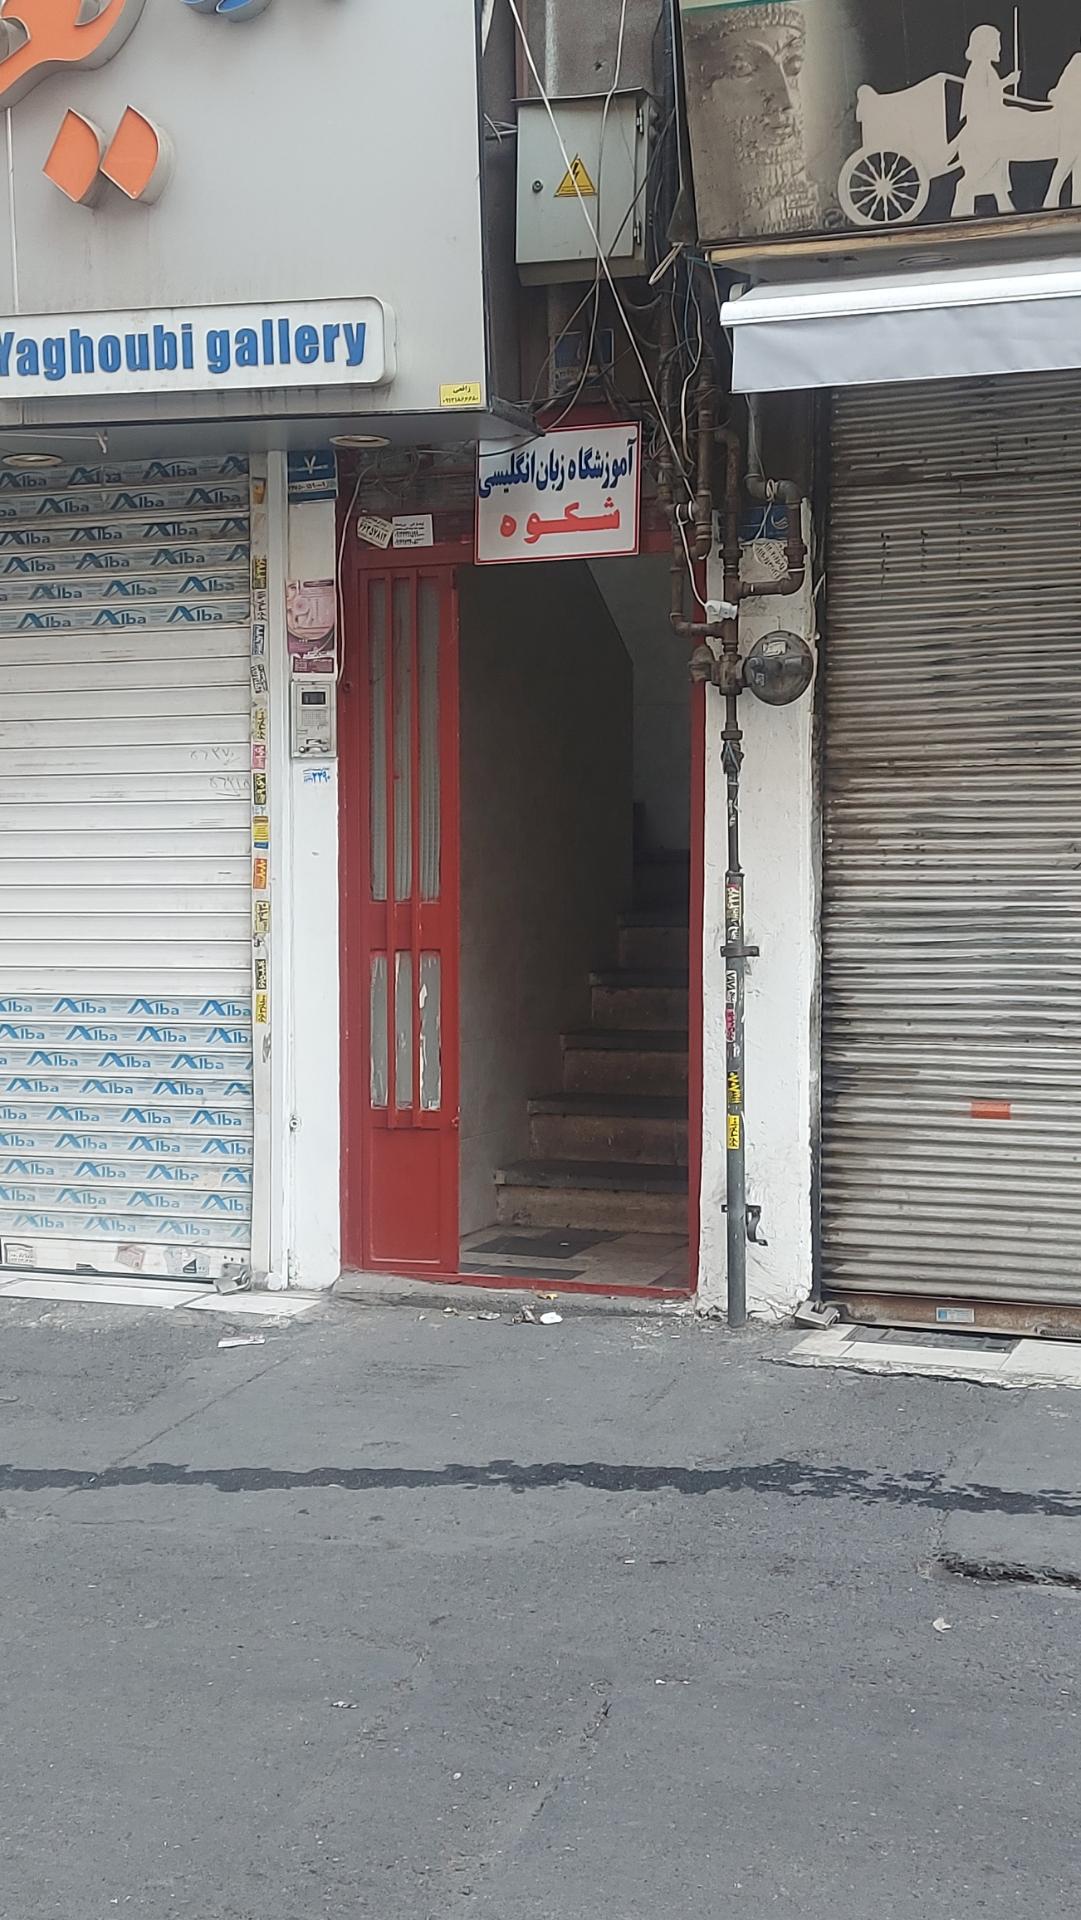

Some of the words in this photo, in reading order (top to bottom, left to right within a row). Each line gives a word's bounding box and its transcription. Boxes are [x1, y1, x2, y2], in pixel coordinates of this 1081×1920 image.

[0, 323, 194, 381] Yaghoubi
[206, 318, 366, 374] gallery
[478, 451, 535, 498] انگلیسی
[536, 448, 566, 491] زبان
[568, 438, 637, 488] آموزشگاه
[499, 496, 620, 544] شکوه
